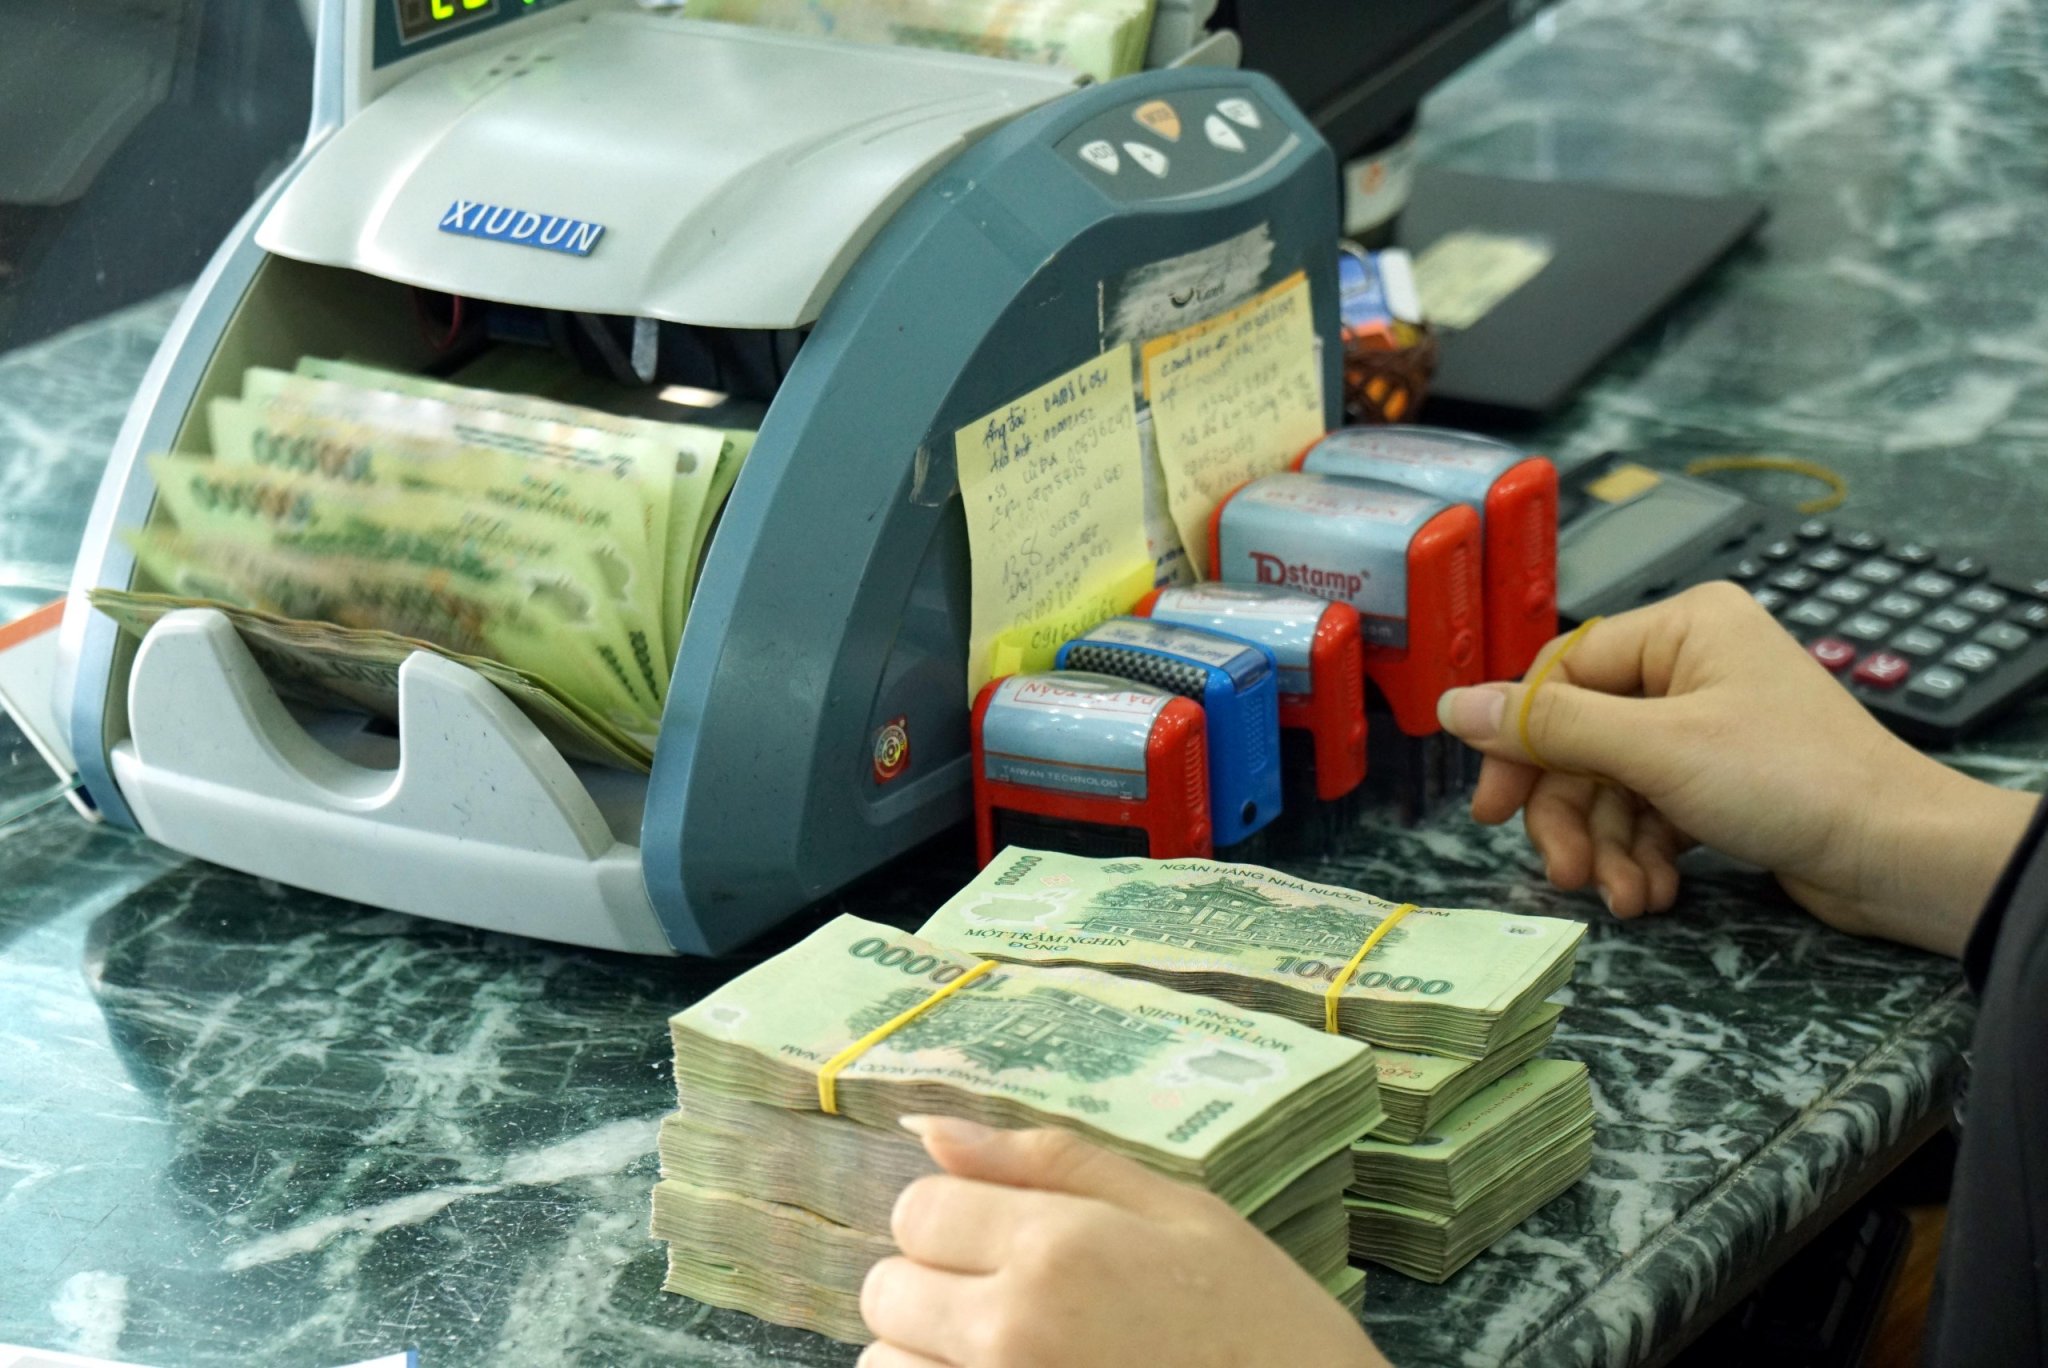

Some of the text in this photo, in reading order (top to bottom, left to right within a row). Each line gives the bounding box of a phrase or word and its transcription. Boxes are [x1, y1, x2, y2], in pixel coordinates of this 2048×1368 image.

[442, 200, 602, 251] XIUDUN
[1002, 765, 1126, 788] TAIWAN TECHNOLOGY
